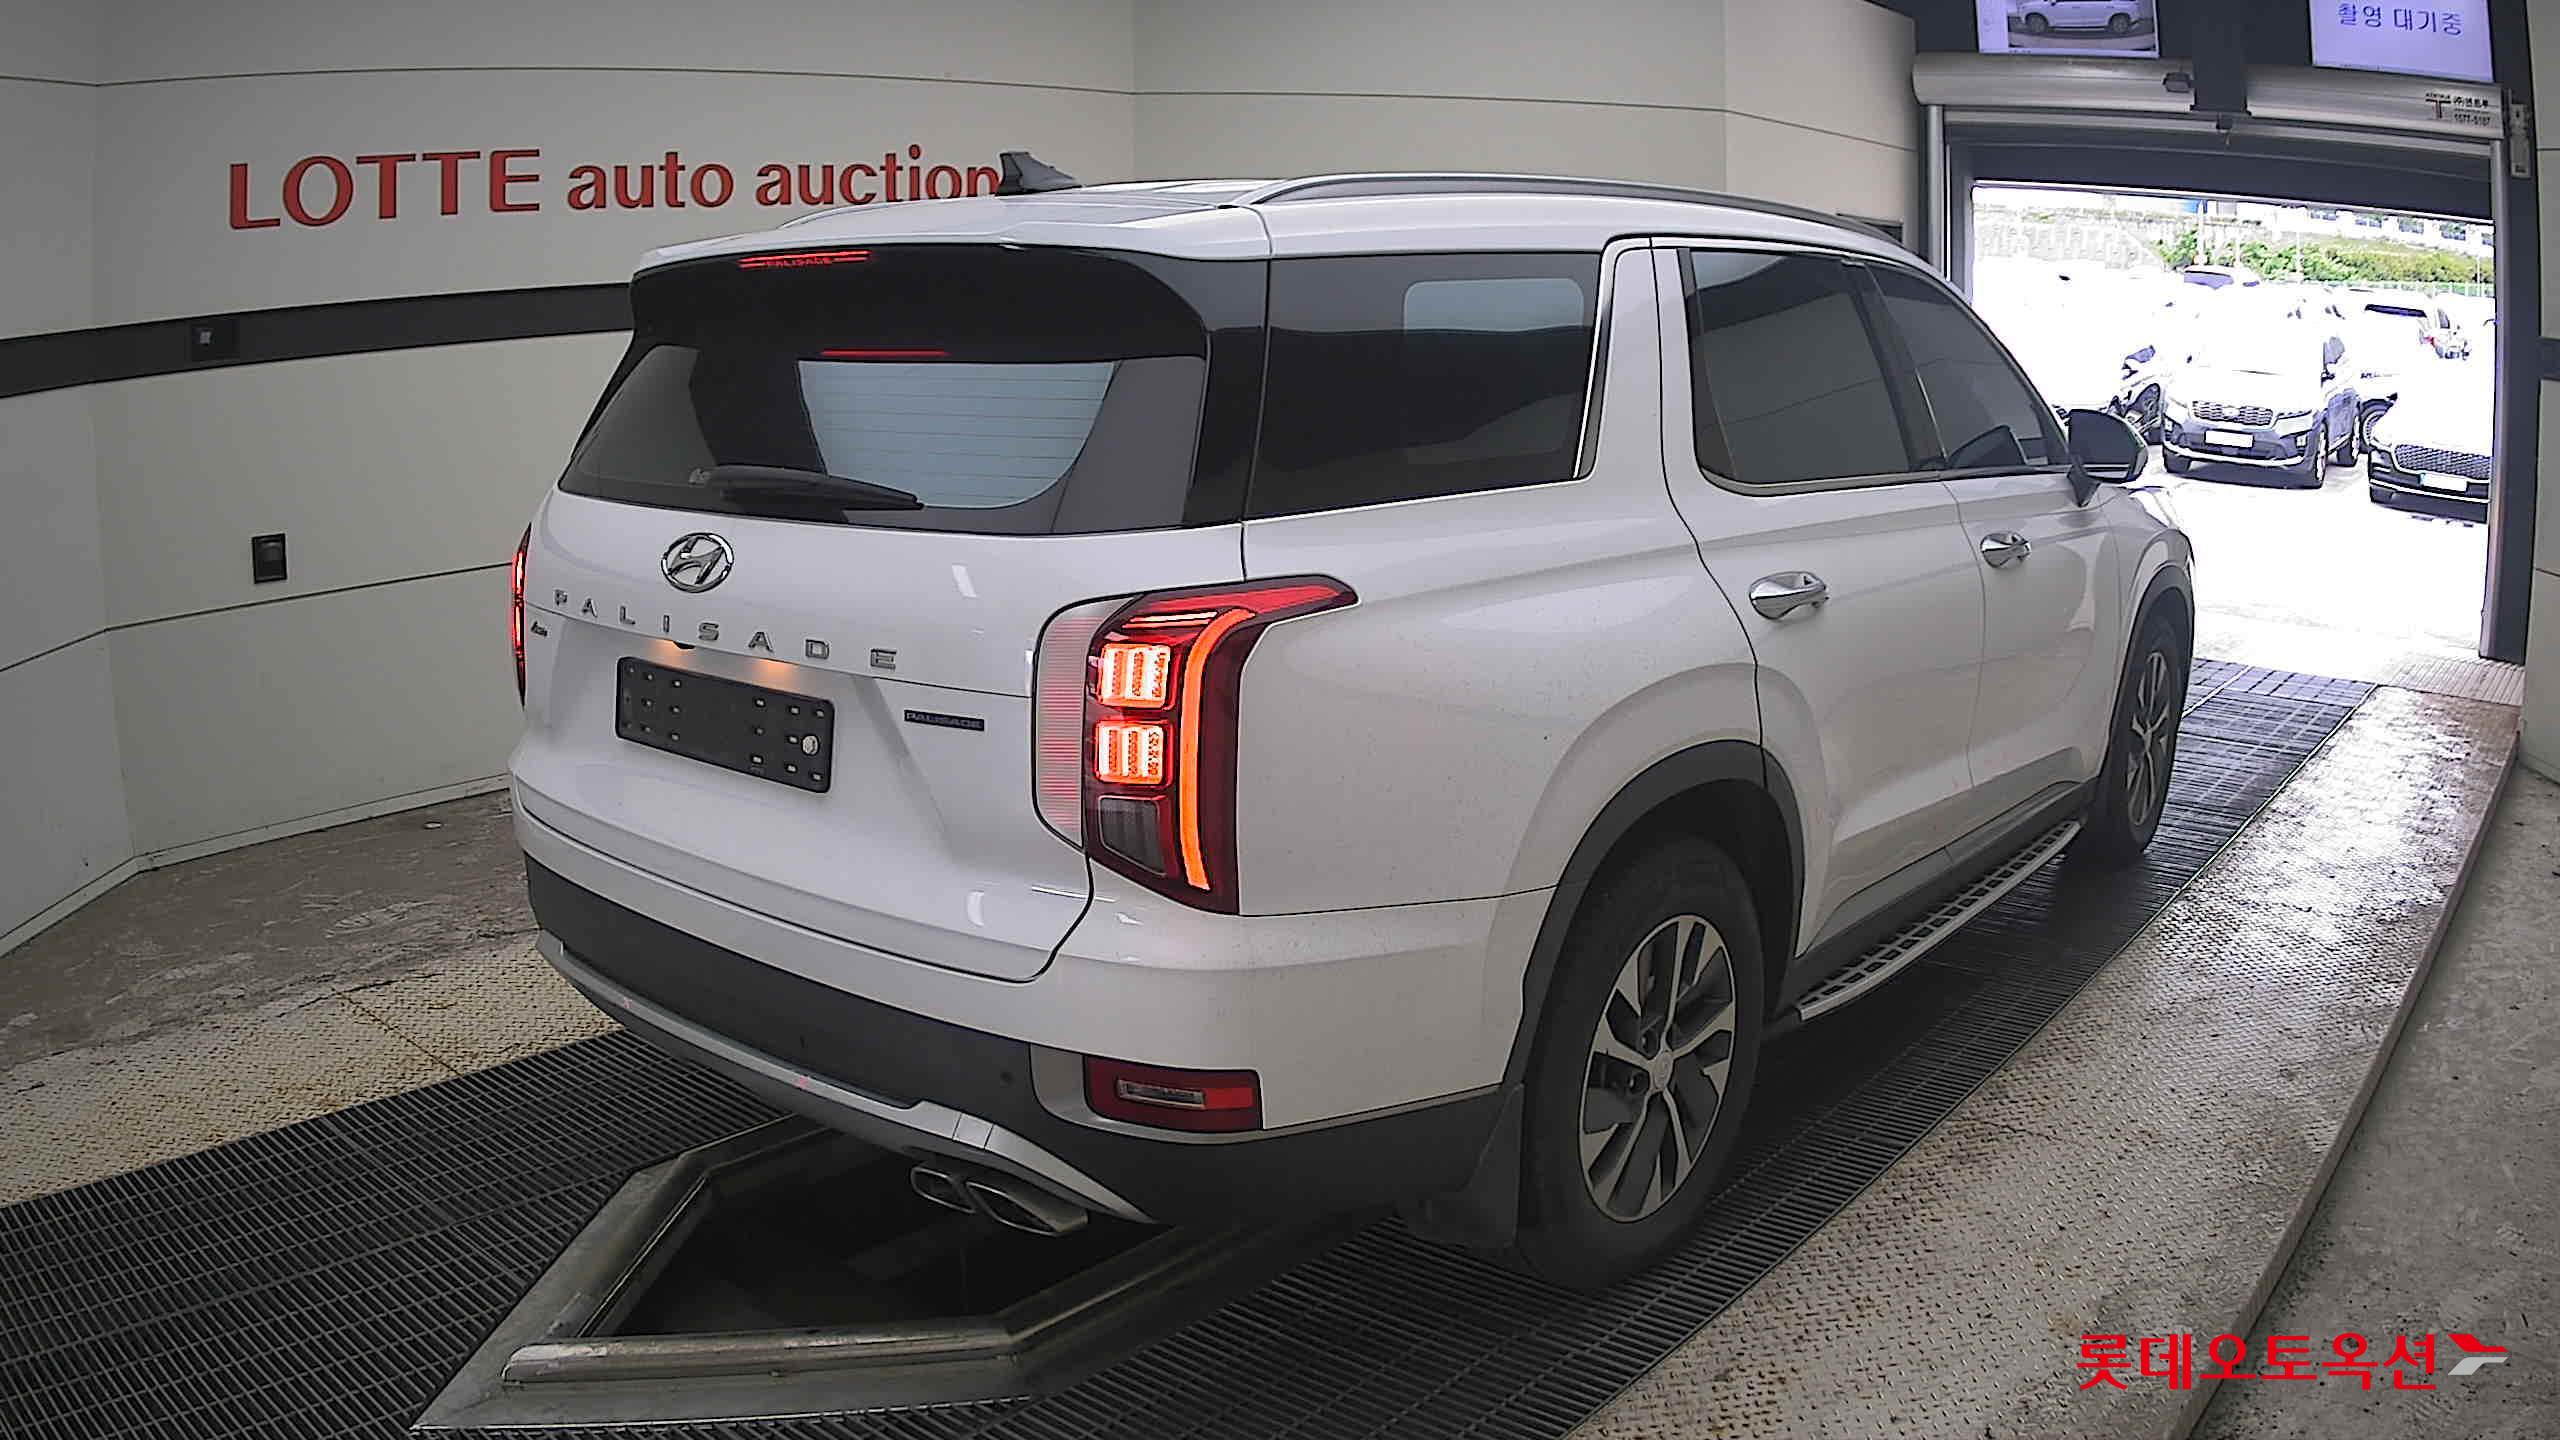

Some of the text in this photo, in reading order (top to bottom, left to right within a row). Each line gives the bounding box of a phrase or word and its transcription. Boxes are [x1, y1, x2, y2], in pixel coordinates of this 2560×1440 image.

[2339, 3, 2462, 36] 촬영 대기중
[230, 145, 1000, 229] LOTTE auto auction
[553, 588, 898, 670] PALISADE
